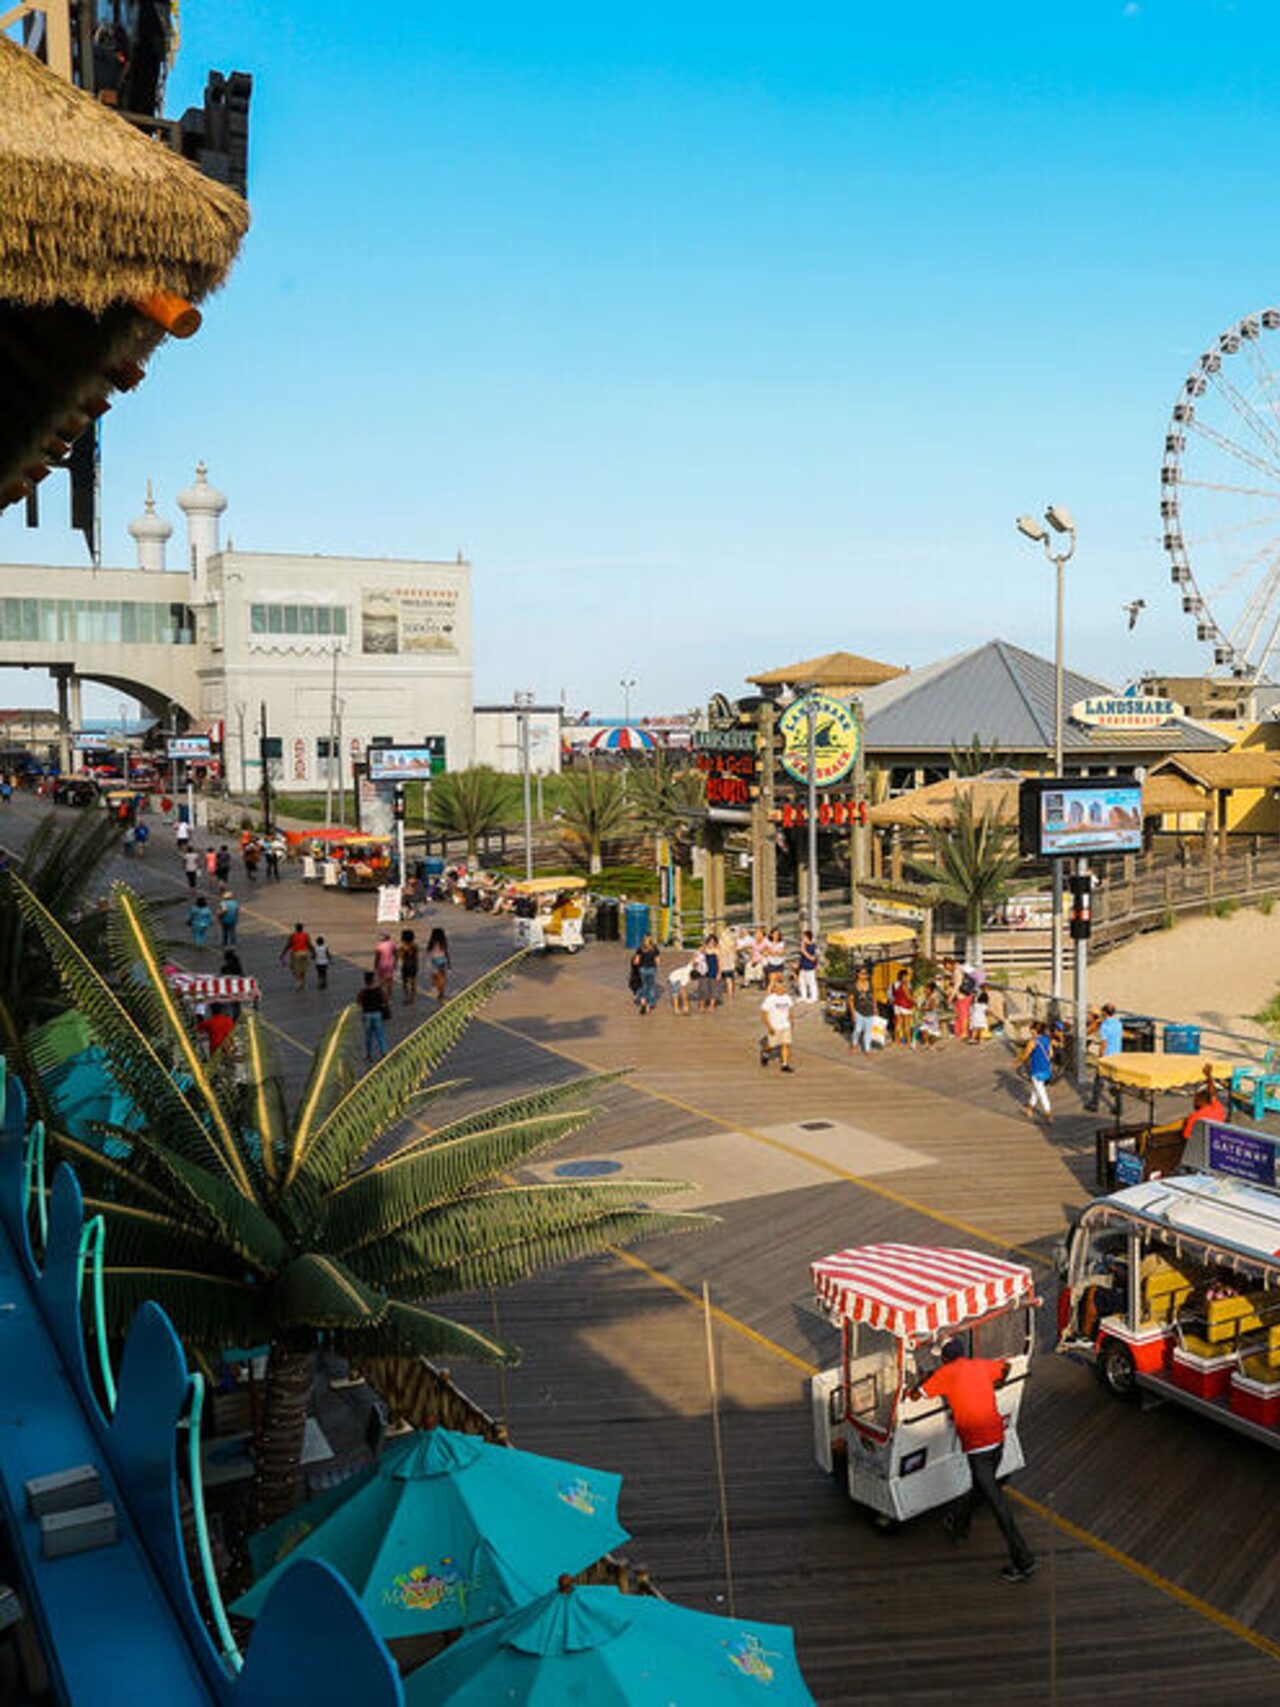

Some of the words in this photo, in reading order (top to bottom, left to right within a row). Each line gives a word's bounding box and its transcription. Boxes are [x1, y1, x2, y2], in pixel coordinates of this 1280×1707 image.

[1085, 700, 1174, 714] LANDSHARK
[782, 801, 867, 828] REORTS
[1212, 1140, 1268, 1163] GATEWAY
